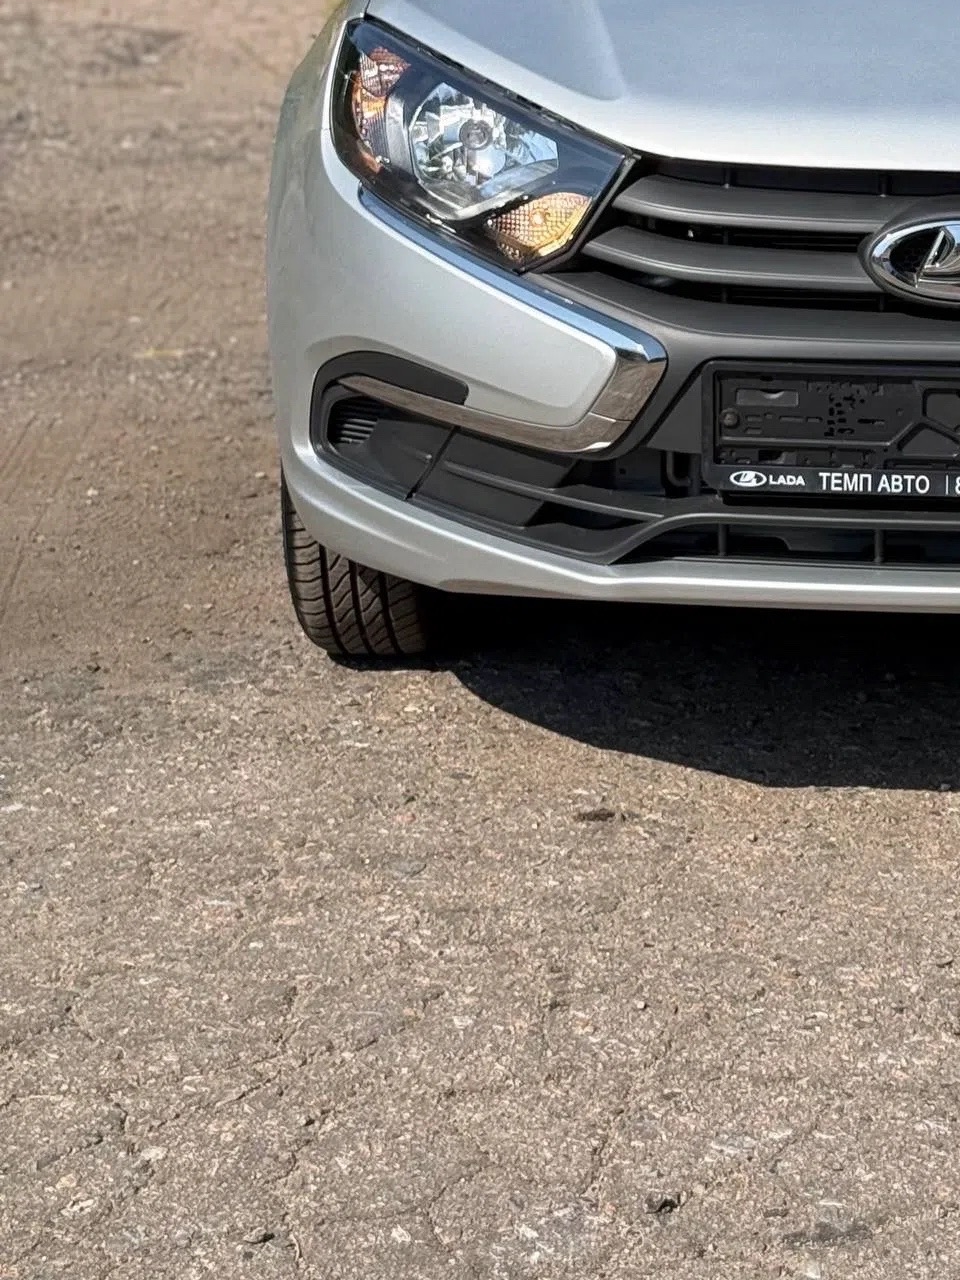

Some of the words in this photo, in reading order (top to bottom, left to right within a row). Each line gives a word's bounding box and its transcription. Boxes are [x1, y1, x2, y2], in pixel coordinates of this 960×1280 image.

[768, 474, 806, 487] LADA
[818, 471, 873, 493] ТЕМП
[876, 473, 931, 495] АВТО
